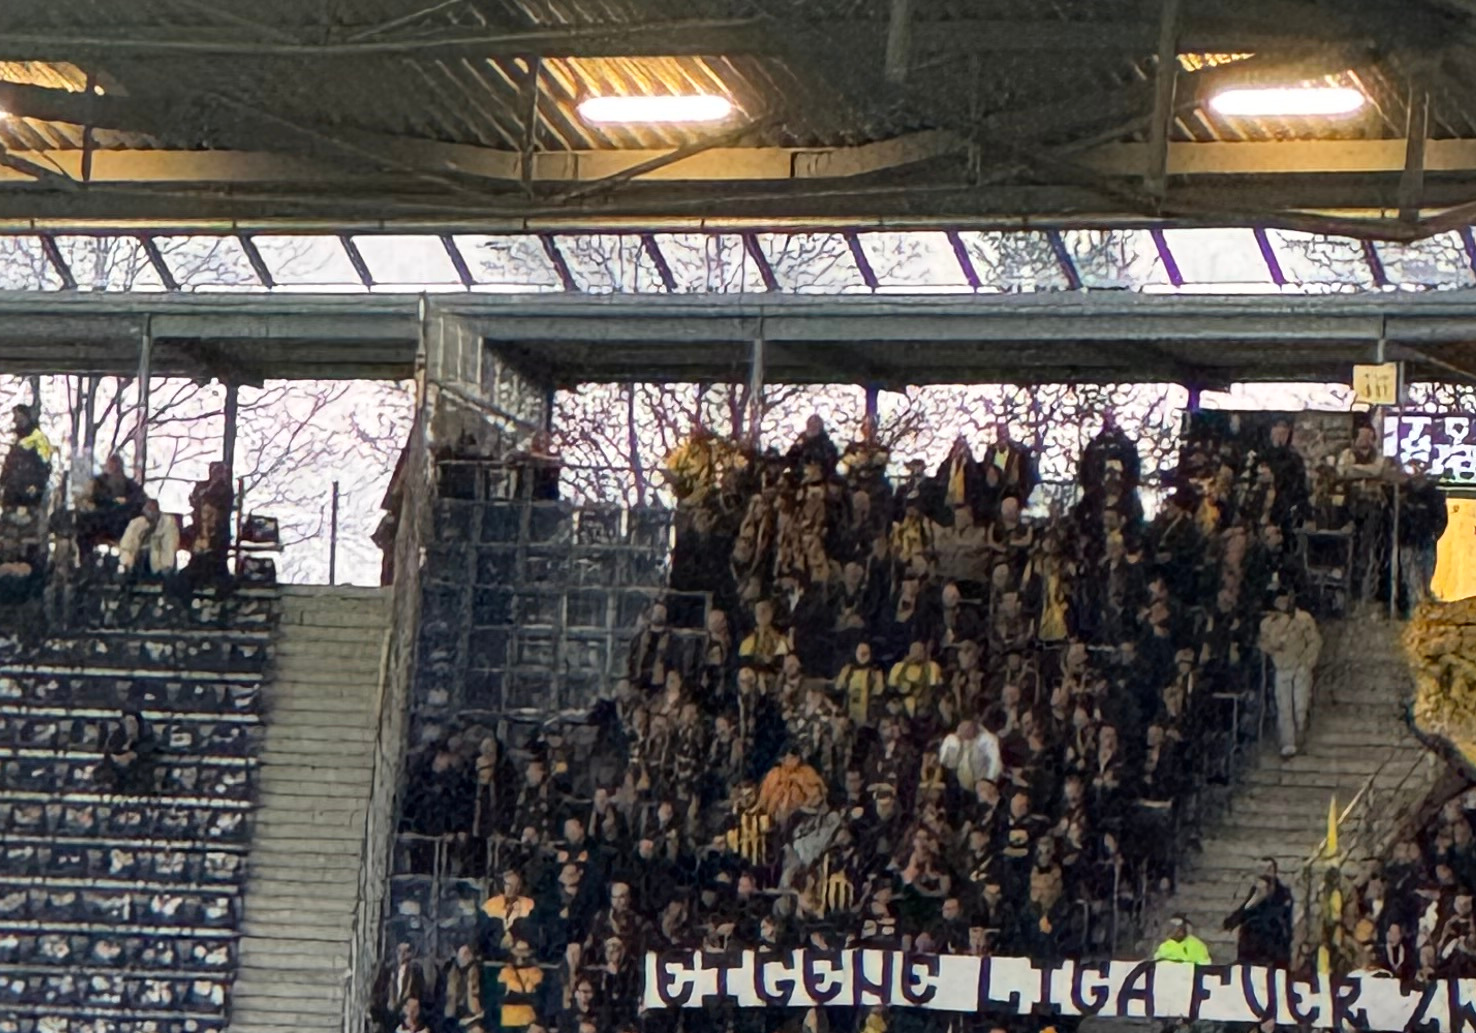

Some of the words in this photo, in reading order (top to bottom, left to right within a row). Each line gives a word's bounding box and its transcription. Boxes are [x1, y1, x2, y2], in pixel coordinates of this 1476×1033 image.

[655, 950, 940, 1008] EIGENE
[978, 957, 1155, 1018] LIGA
[1189, 964, 1369, 1029] FUER
